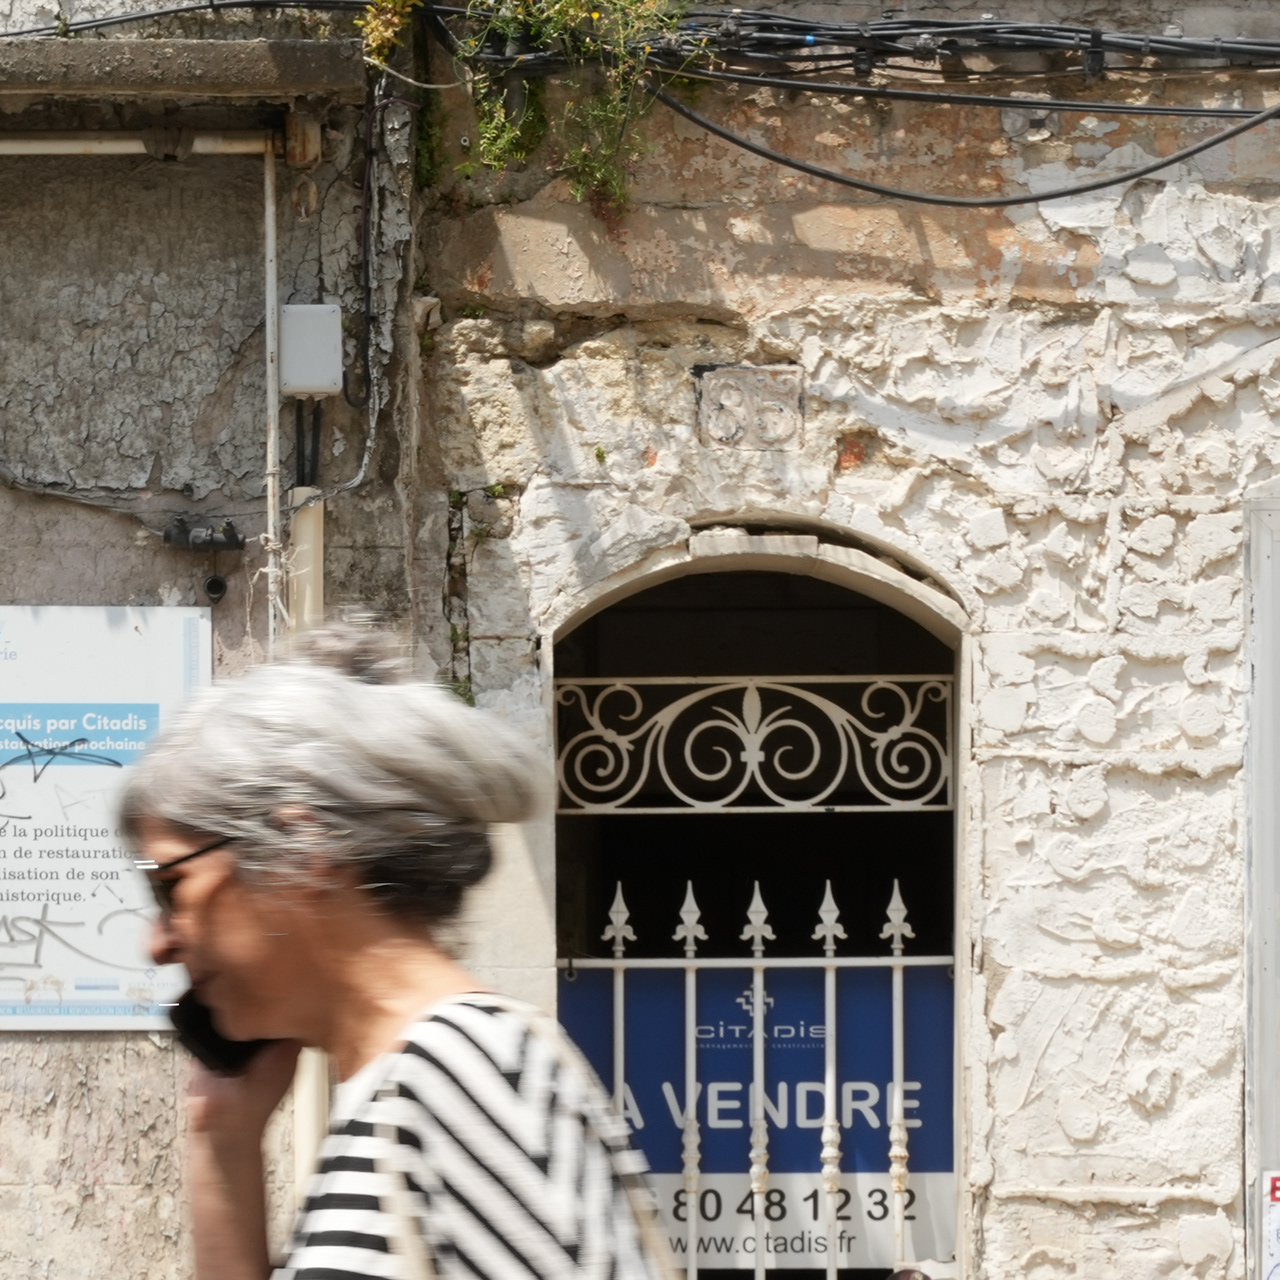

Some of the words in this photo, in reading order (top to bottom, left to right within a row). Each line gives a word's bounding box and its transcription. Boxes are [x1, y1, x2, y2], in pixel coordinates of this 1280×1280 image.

[46, 715, 77, 734] par
[81, 712, 148, 731] Citadis
[74, 736, 147, 754] prochaine
[12, 824, 28, 838] la
[32, 824, 110, 841] politique
[65, 866, 85, 881] de
[90, 870, 121, 881] son
[661, 1081, 923, 1130] VENDRE
[672, 1188, 723, 1222] 80
[735, 1188, 788, 1222] 48
[802, 1188, 852, 1222] 12
[866, 1188, 917, 1222] 32
